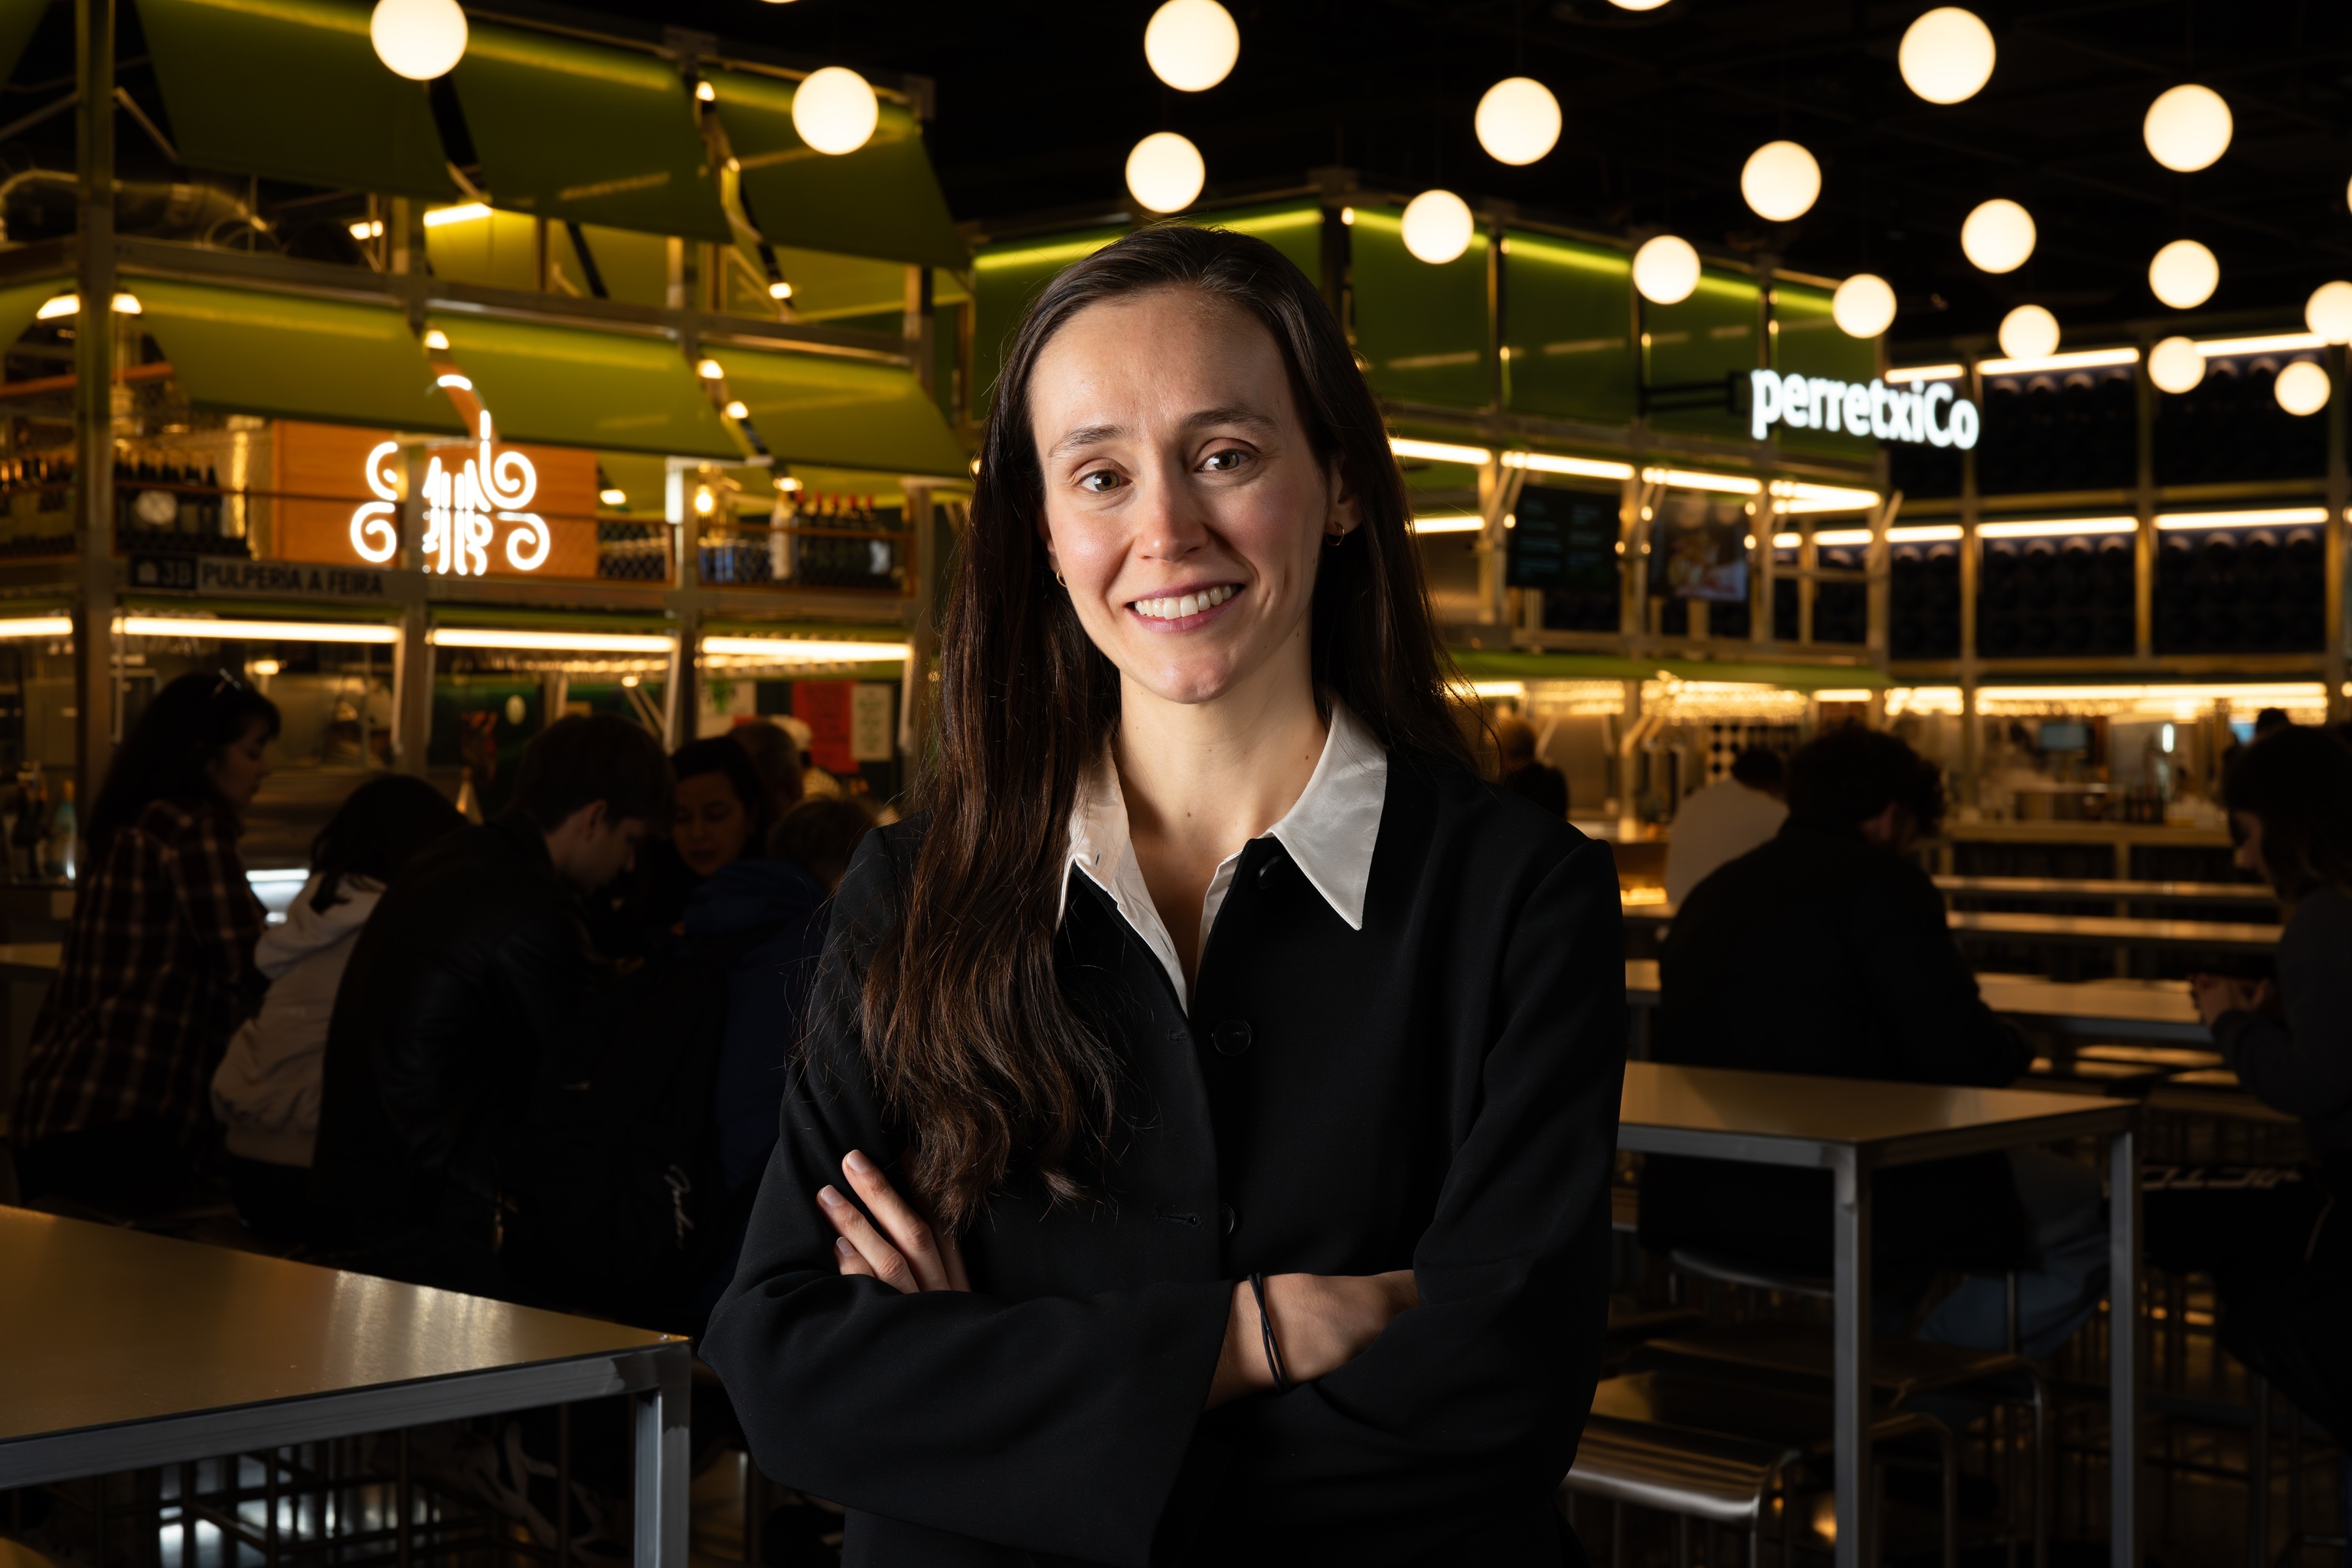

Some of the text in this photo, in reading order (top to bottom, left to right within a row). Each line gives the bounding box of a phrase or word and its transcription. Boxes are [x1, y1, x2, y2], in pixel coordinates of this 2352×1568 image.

[1751, 369, 1980, 449] perretxiCo
[307, 570, 324, 593] A
[327, 570, 384, 594] FEIRA
